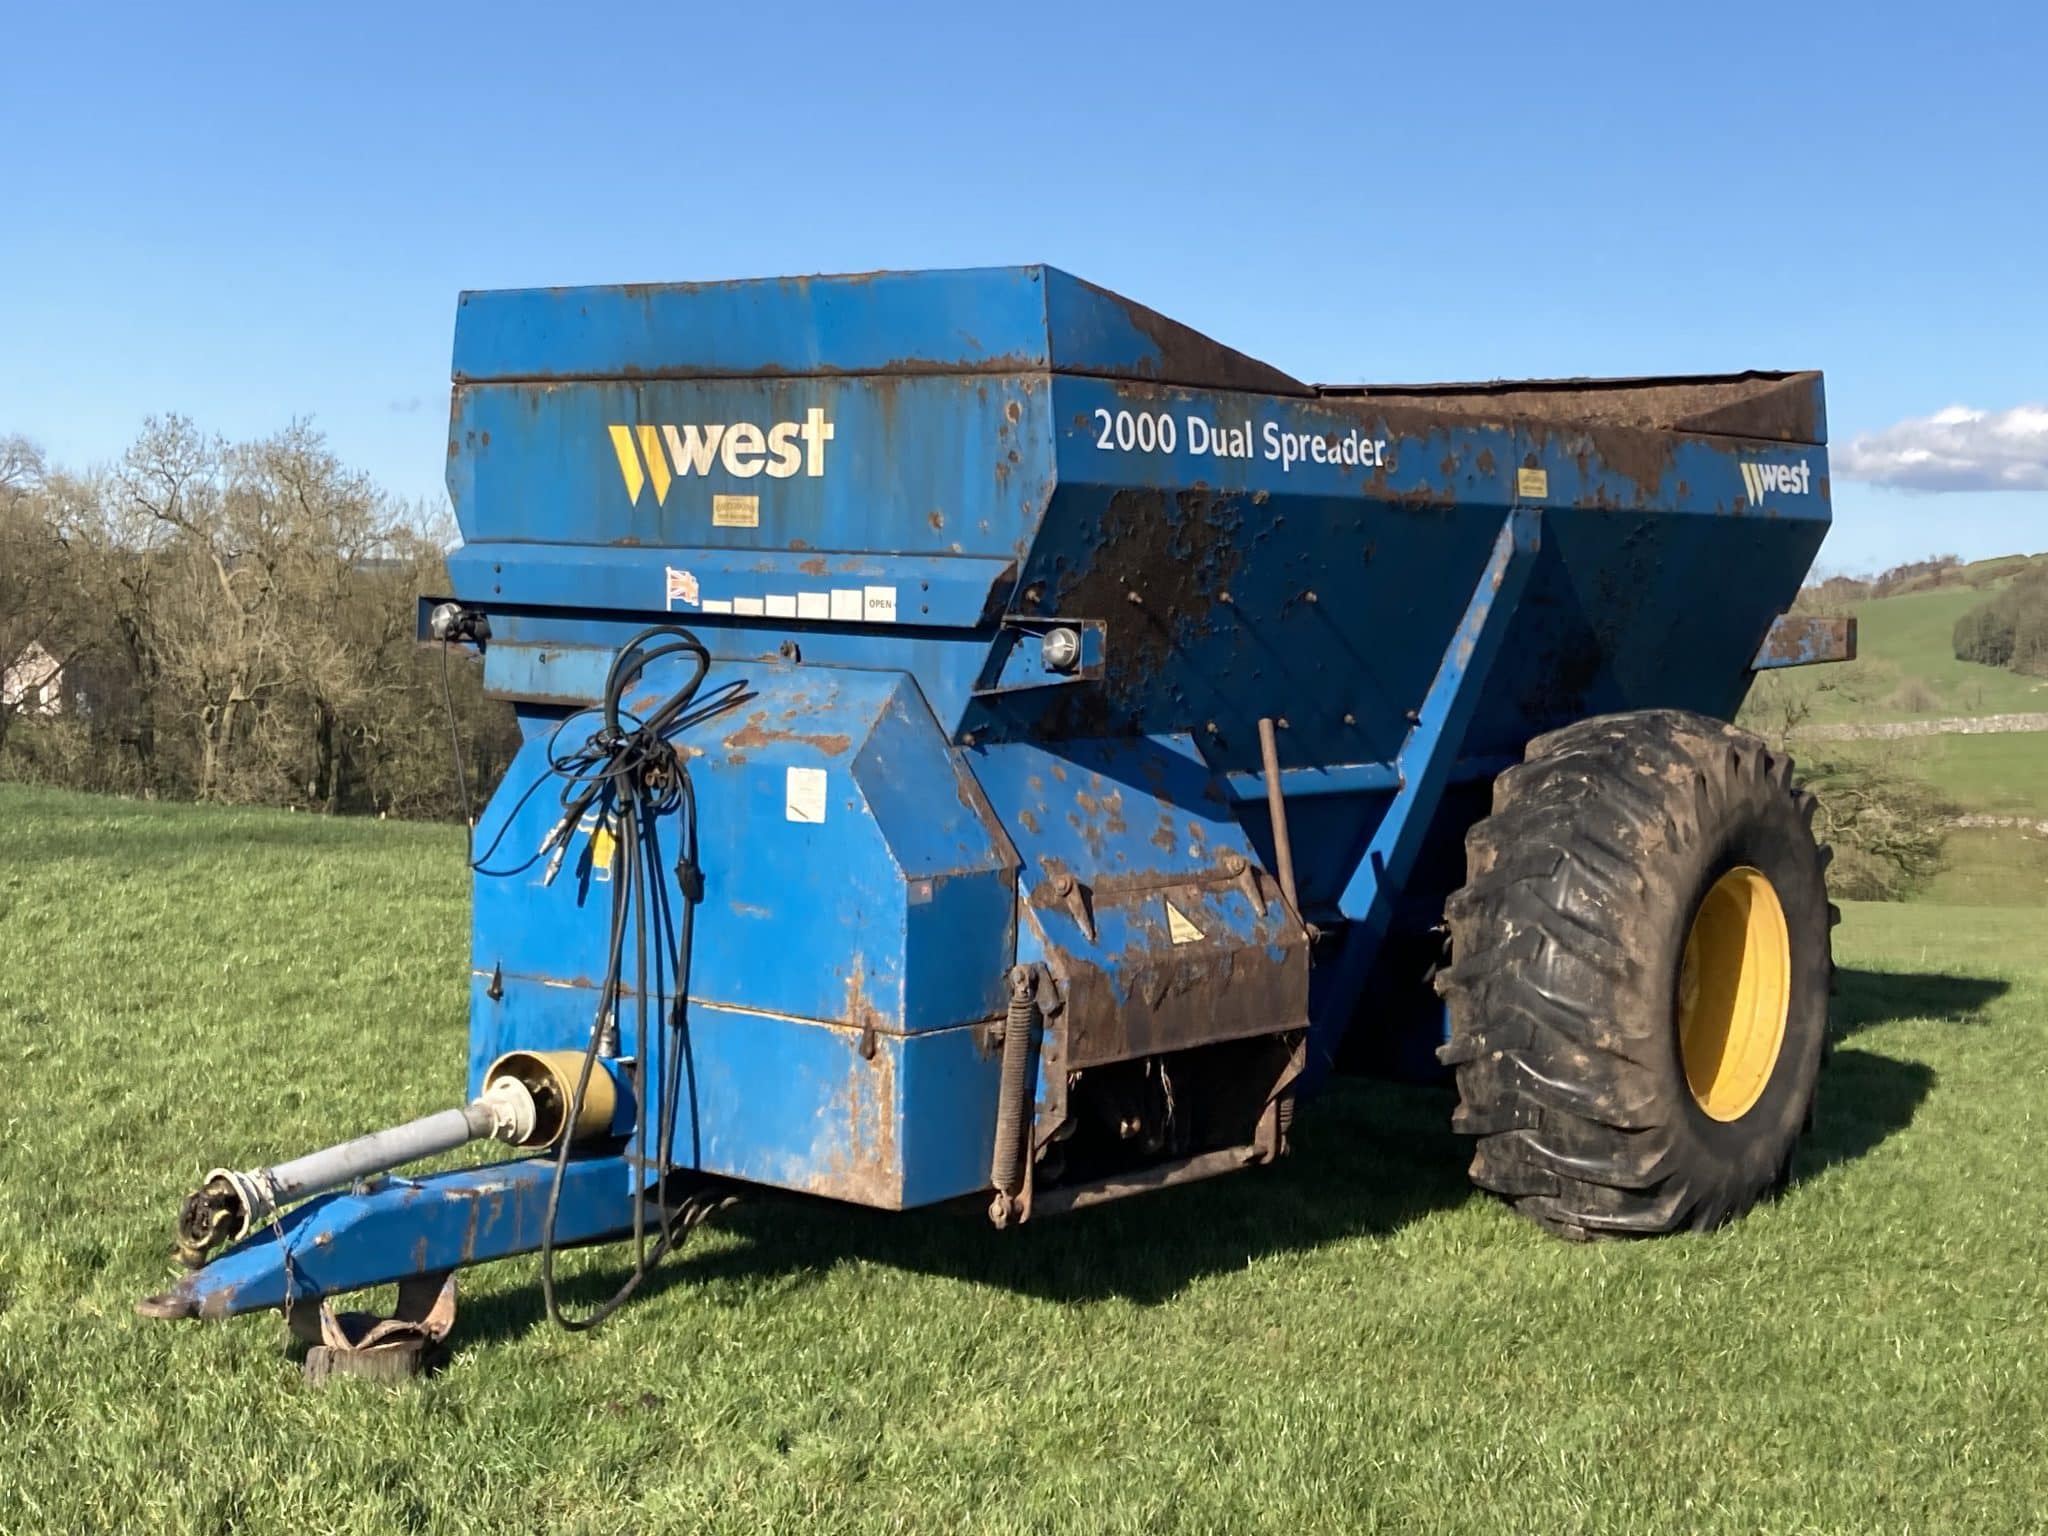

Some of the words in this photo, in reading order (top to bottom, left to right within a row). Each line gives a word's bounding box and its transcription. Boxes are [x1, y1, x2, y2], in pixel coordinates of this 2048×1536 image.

[661, 407, 834, 479] west
[1094, 408, 1177, 454] 2000
[1187, 415, 1254, 458] Dual
[1263, 421, 1386, 472] Spreader
[1758, 459, 1810, 494] west
[869, 599, 892, 609] OPEN
